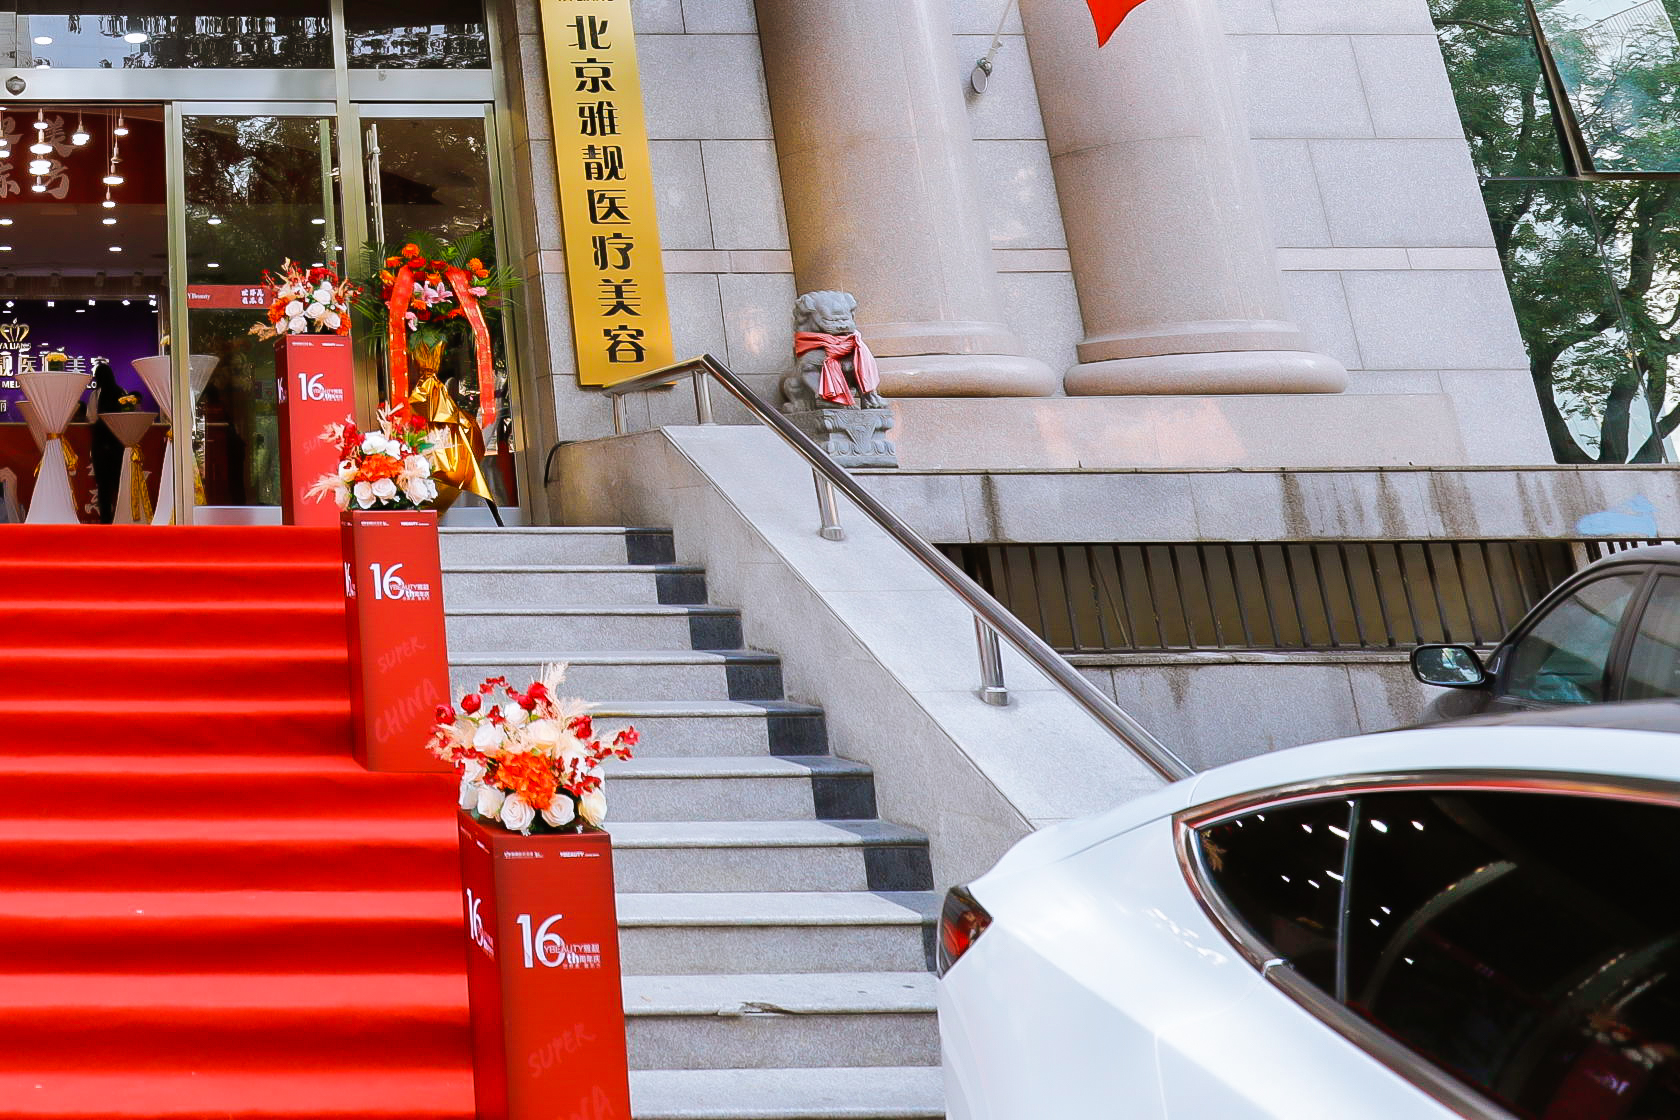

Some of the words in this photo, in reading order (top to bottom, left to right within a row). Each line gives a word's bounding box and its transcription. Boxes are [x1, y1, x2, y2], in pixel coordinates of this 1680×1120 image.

[566, 15, 648, 364] 北京雅靓医疗美容
[298, 372, 324, 401] 16
[369, 562, 403, 600] 16
[377, 635, 427, 673] SUPER
[374, 677, 440, 744] CHINA
[466, 887, 483, 947] 16
[516, 913, 564, 968] 16
[527, 1023, 597, 1078] SUPER
